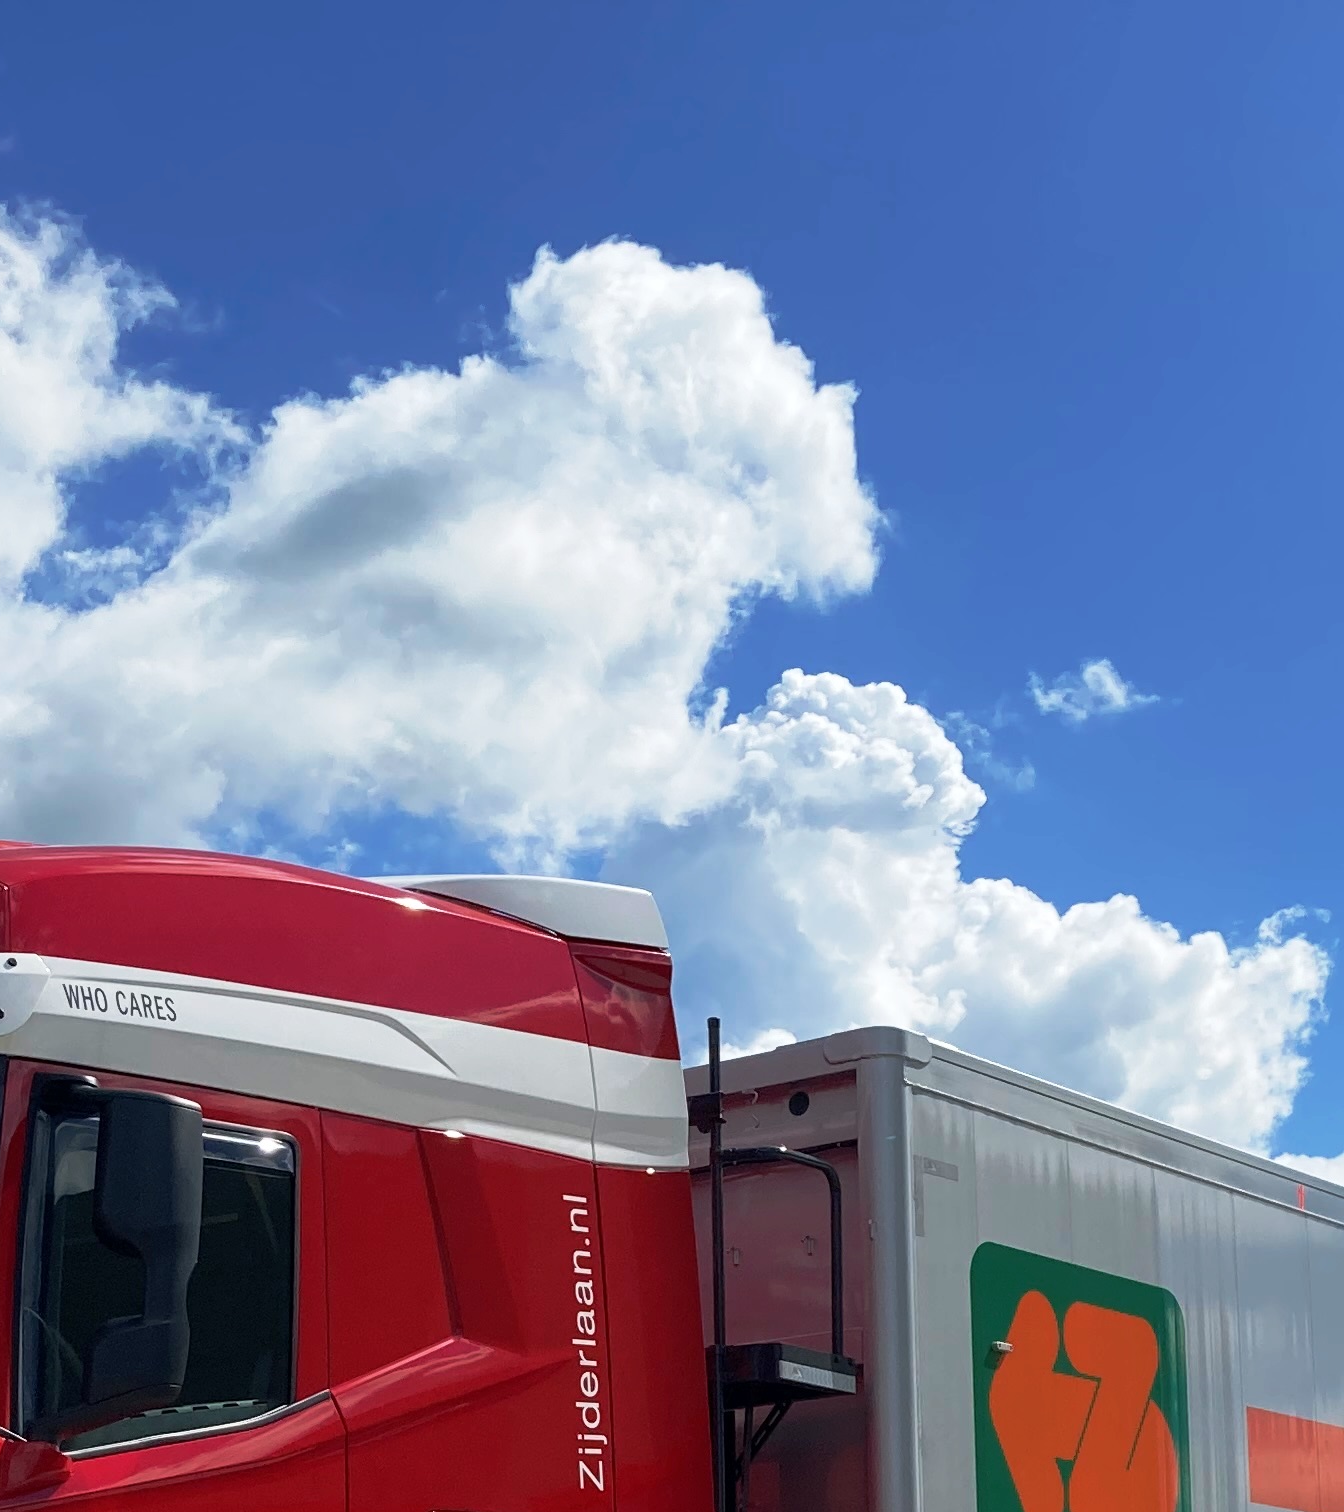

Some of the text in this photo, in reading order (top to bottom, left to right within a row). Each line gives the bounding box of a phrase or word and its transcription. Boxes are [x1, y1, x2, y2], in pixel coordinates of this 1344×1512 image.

[61, 983, 177, 1022] WHO CARES
[562, 1194, 608, 1492] Zijderlaan.nl
